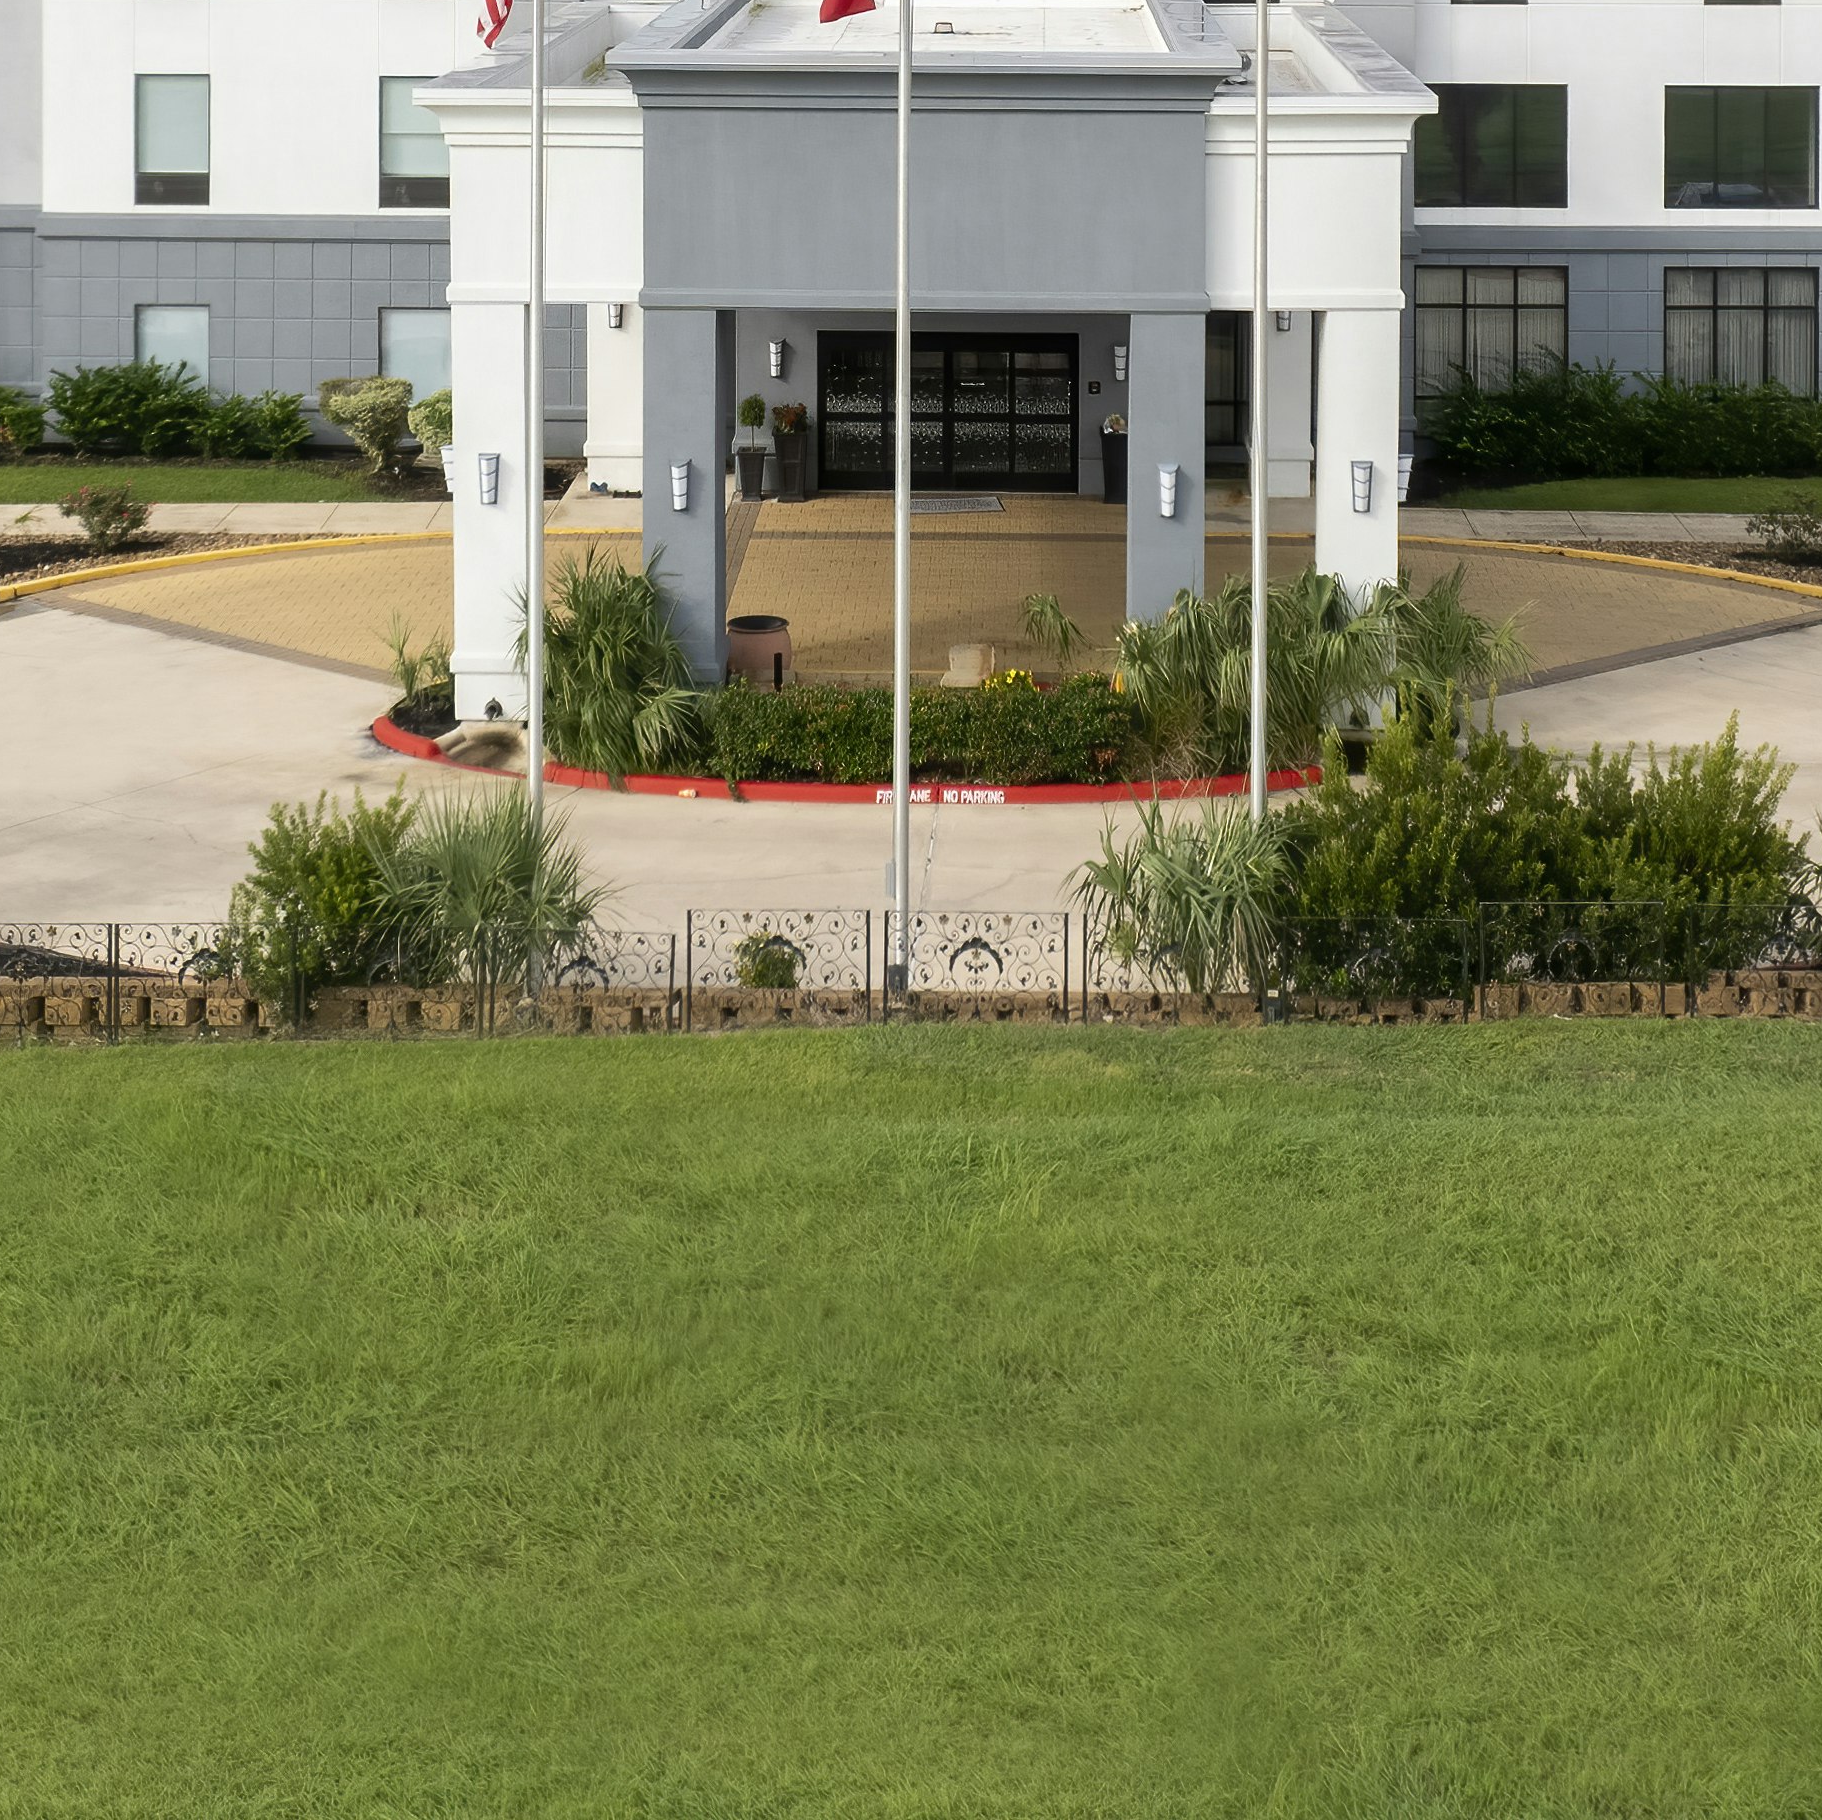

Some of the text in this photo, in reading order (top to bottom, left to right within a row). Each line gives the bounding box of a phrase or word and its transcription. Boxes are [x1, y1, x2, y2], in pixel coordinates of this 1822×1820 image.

[876, 789, 1005, 804] FIR ANE NO PARKING
